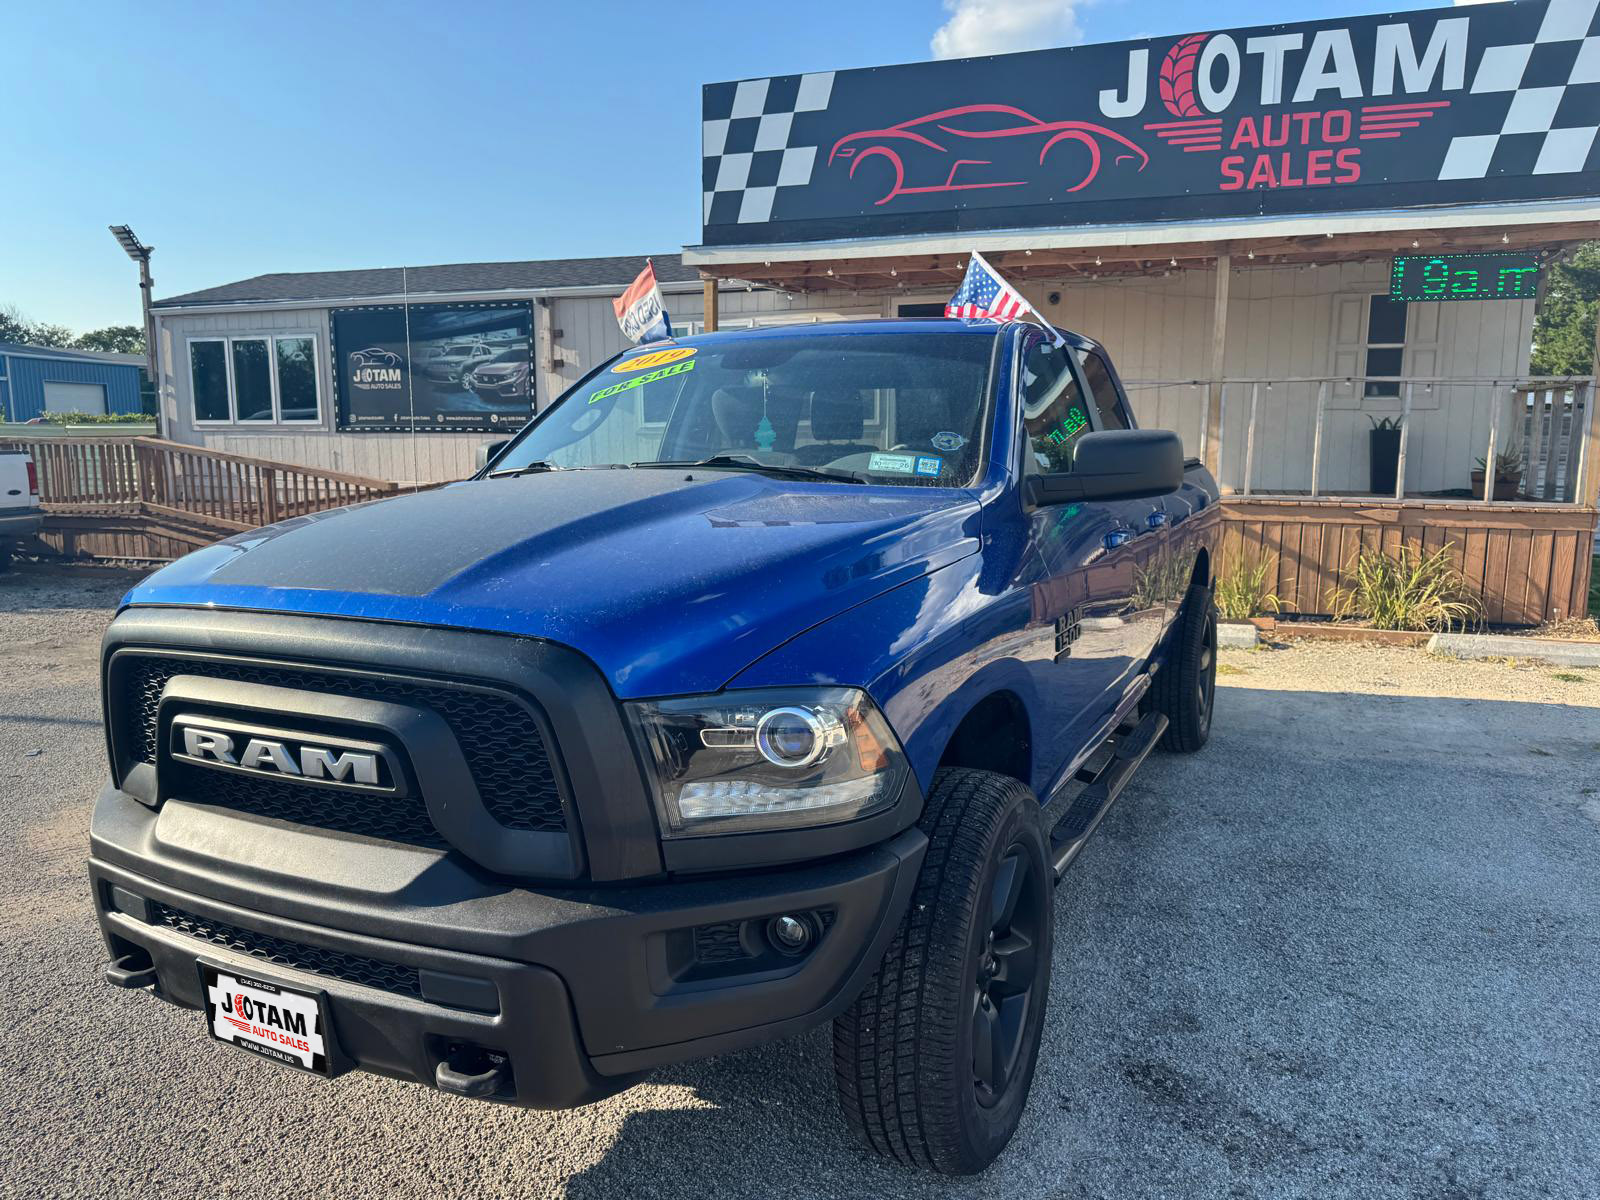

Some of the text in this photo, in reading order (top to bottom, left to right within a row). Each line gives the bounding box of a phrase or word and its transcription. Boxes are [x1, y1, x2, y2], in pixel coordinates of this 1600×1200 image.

[1098, 16, 1470, 119] JOTAM
[1230, 108, 1352, 150] AUTO
[1219, 147, 1362, 191] SALES
[353, 368, 401, 383] JOTAM
[592, 361, 692, 402] FOR SALE
[1059, 606, 1083, 633] RAM
[183, 727, 378, 785] RAM
[221, 992, 308, 1037] JOTAM
[252, 1025, 310, 1052] AUTO SALES
